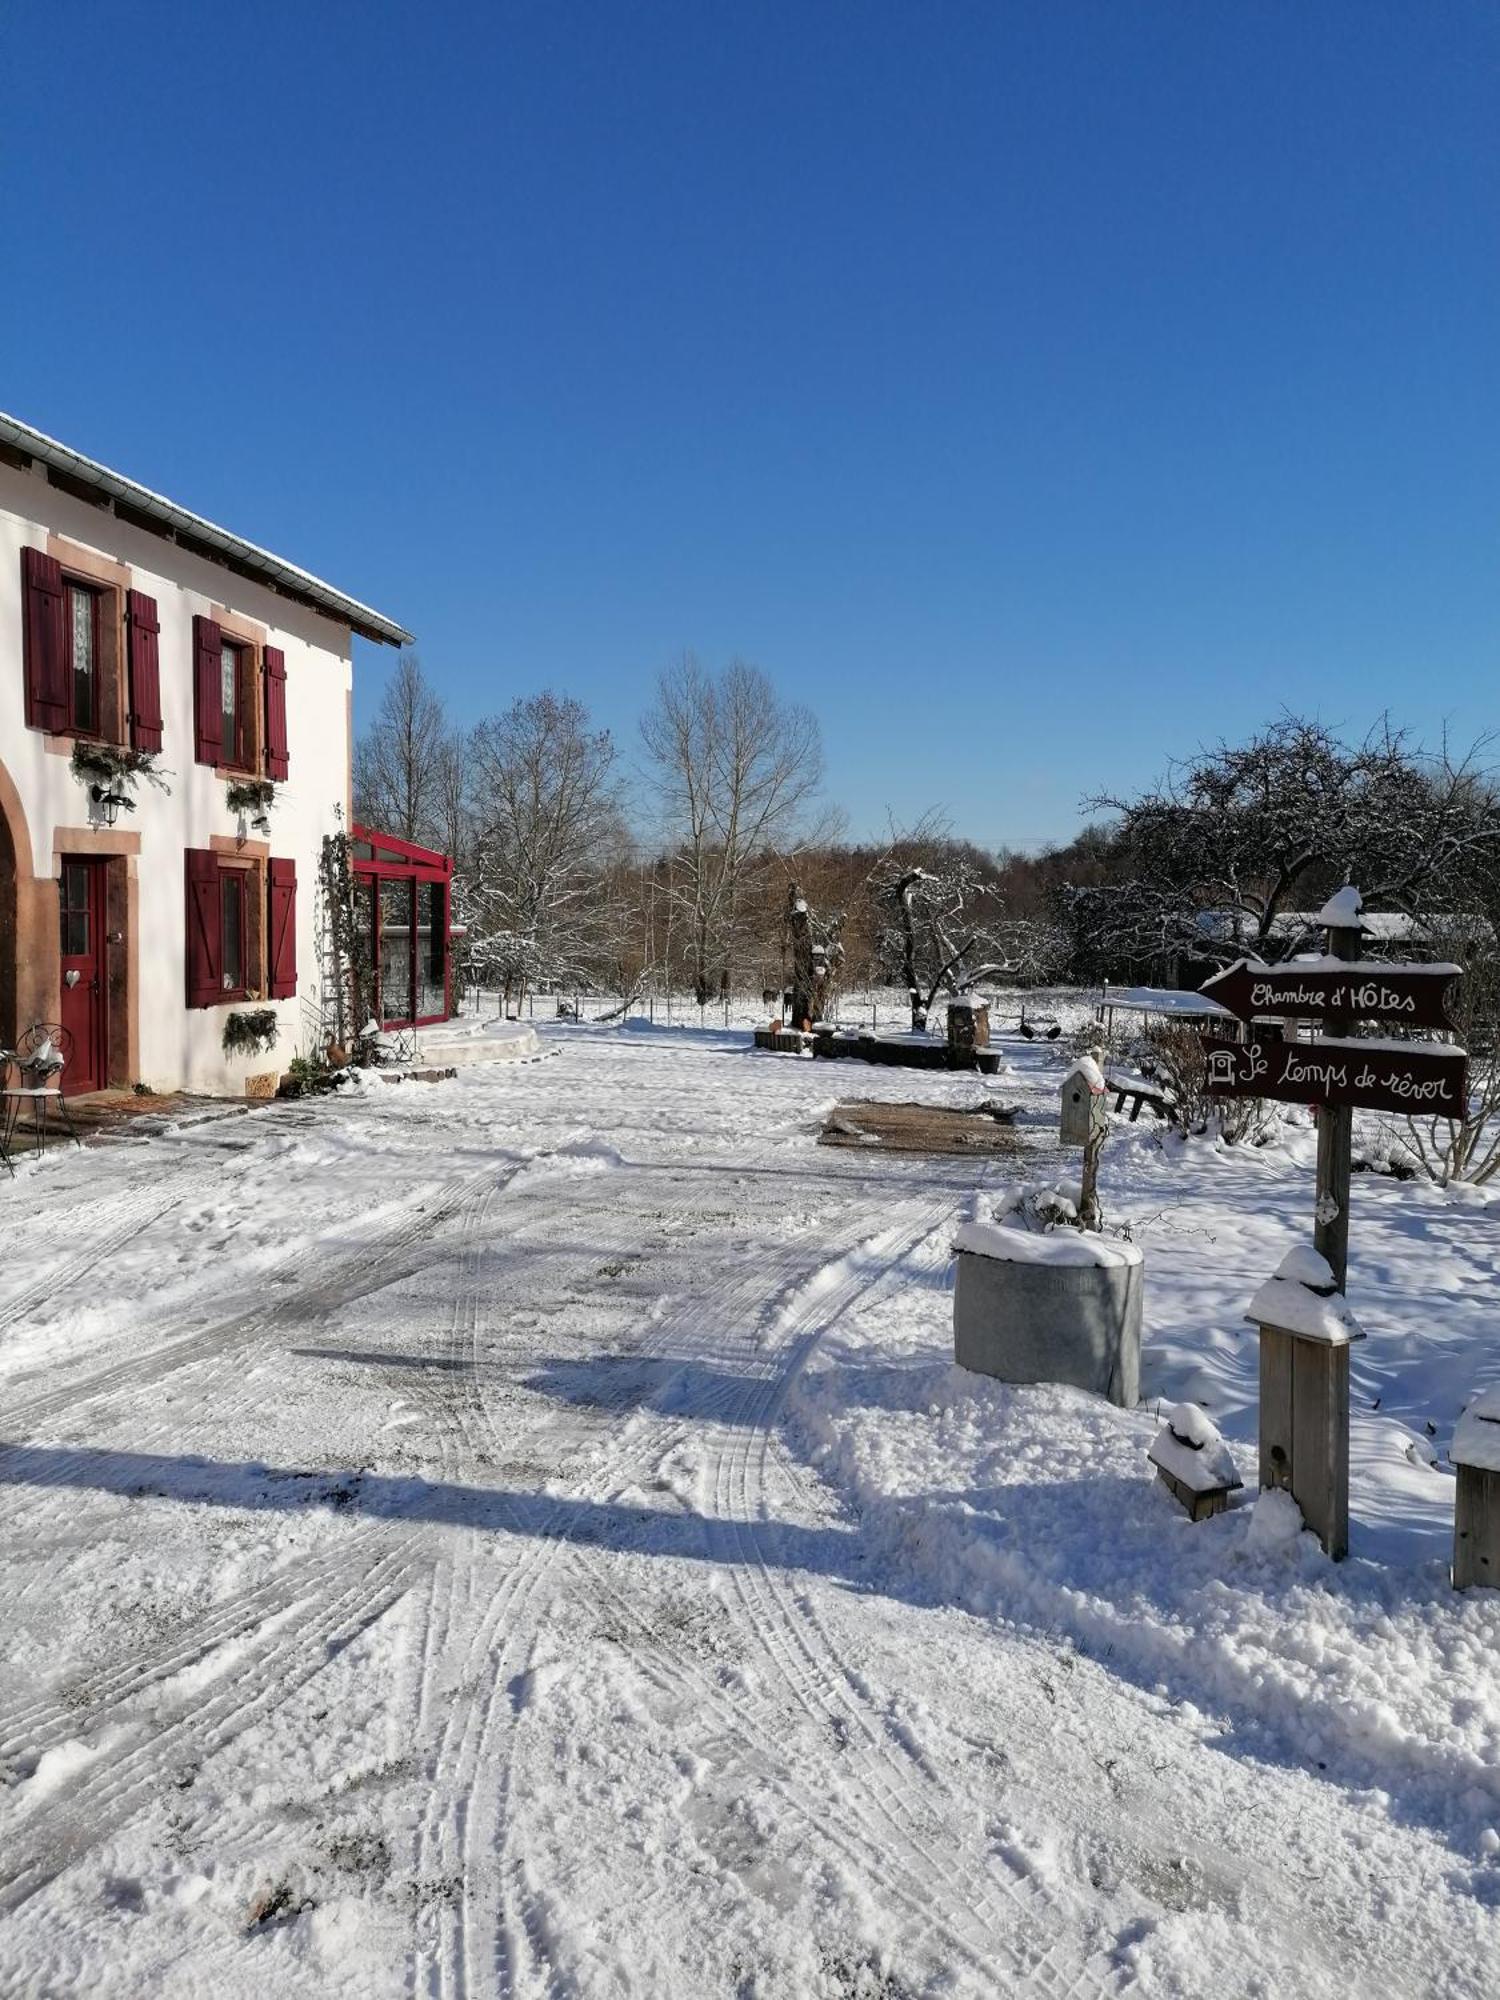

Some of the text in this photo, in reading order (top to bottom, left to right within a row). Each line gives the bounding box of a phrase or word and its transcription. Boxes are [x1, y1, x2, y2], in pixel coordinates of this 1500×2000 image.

[1250, 982, 1416, 1012] Chambre d' Hôtes
[1277, 1051, 1347, 1098] temps
[1354, 1065, 1378, 1088] de
[1381, 1072, 1453, 1100] rêver
